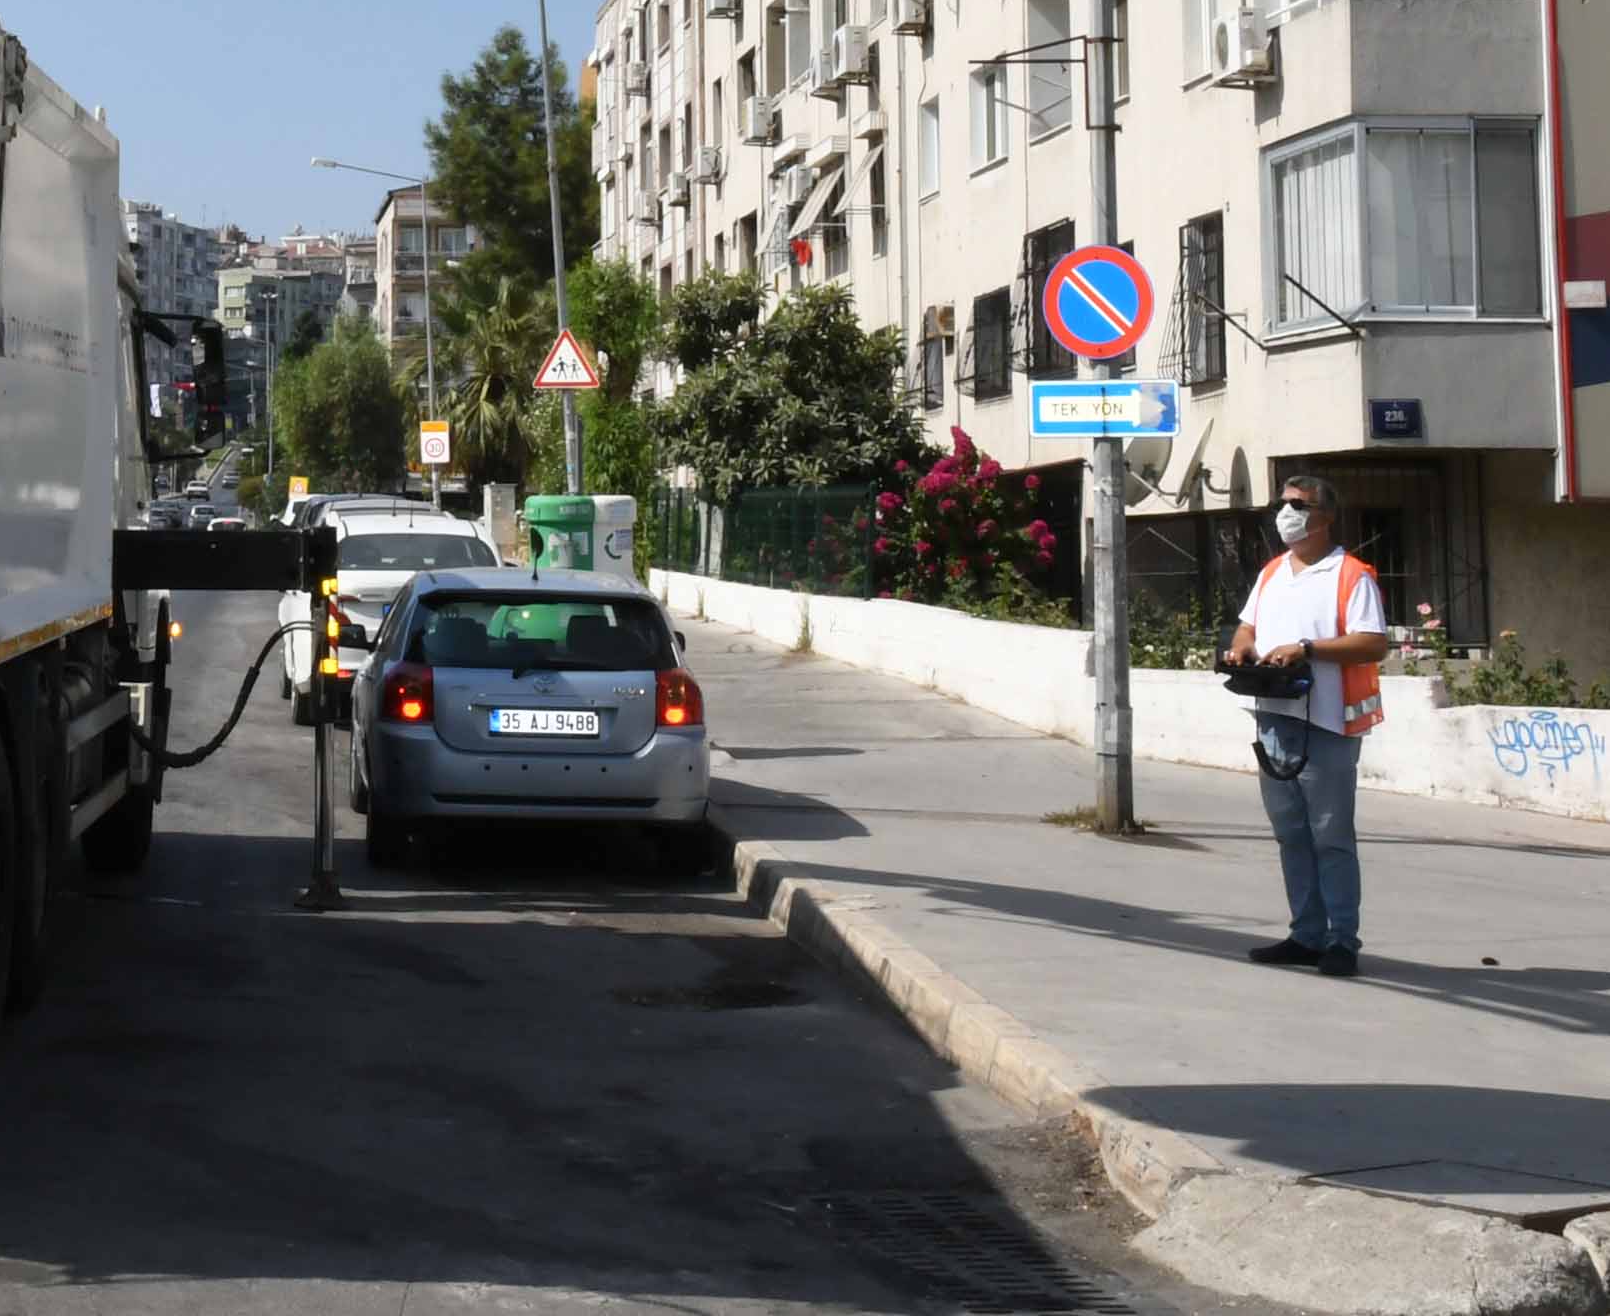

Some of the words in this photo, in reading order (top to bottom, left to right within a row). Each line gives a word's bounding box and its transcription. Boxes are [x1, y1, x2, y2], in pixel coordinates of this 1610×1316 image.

[1052, 403, 1078, 416] TEK
[502, 713, 521, 730] 35
[530, 713, 549, 730] AJ
[556, 715, 595, 731] 9488
